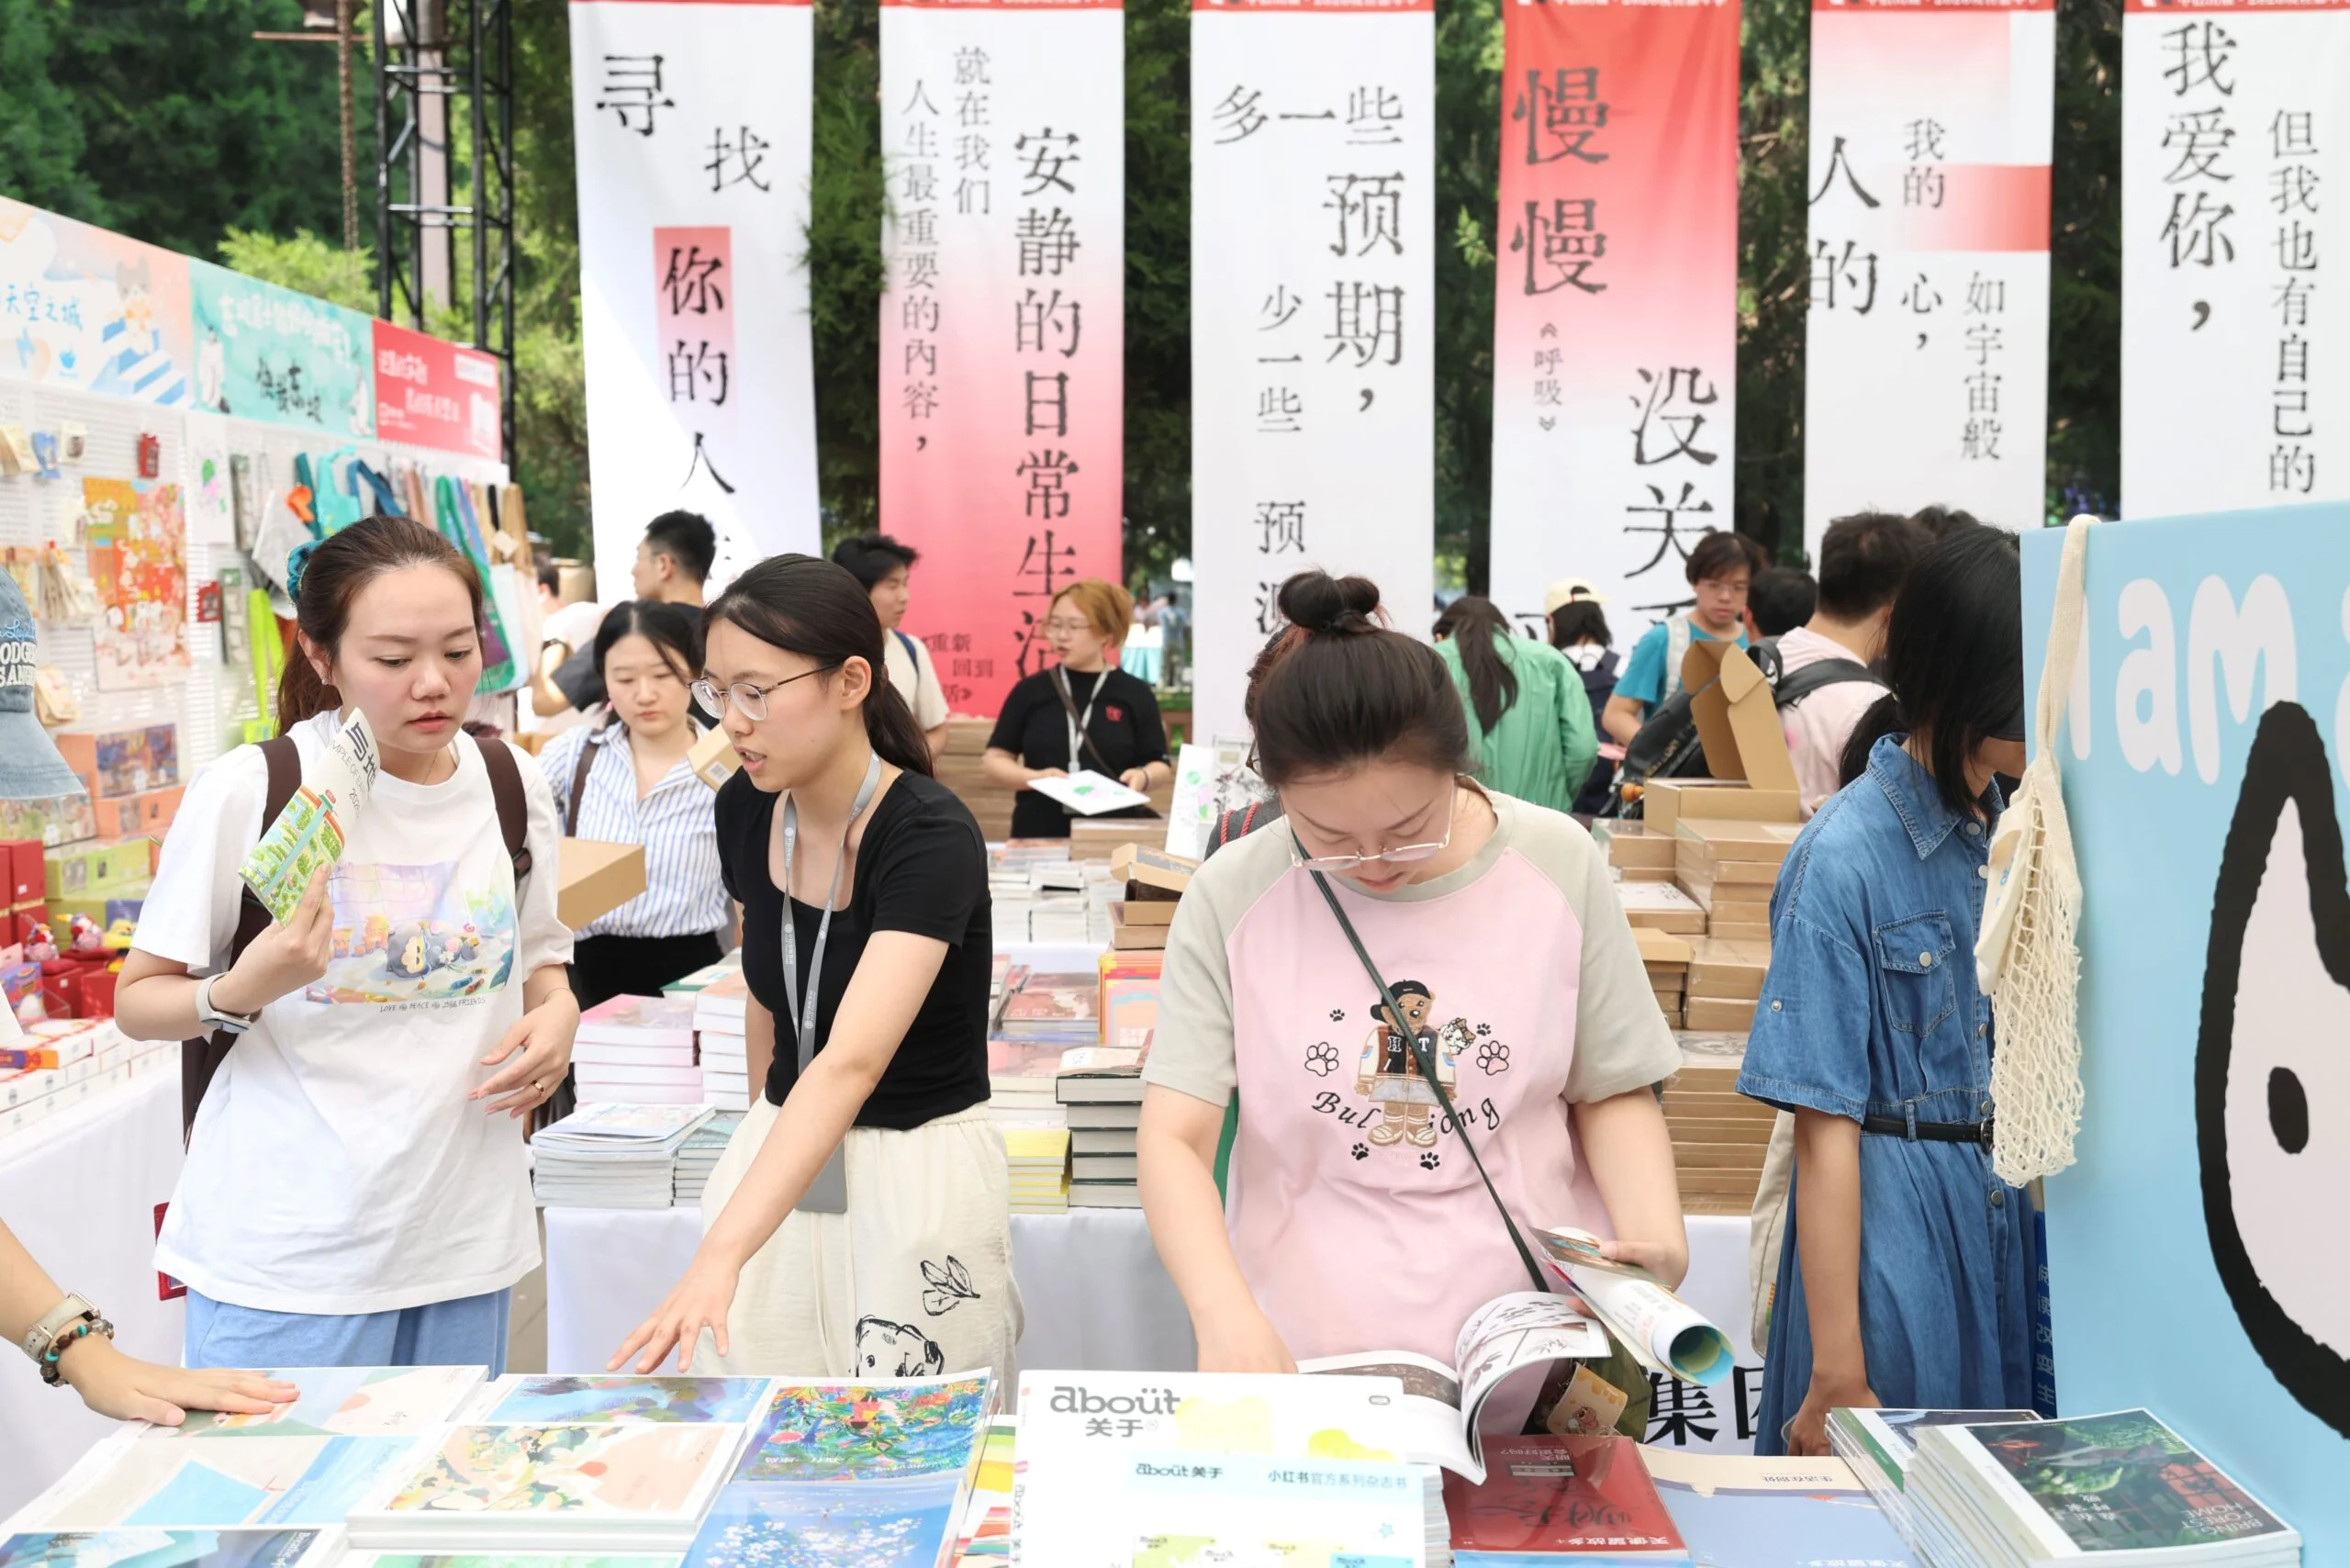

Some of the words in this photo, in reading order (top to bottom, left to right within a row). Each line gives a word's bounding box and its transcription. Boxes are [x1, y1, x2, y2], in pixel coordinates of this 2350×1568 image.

[596, 54, 676, 138] 寻
[704, 125, 772, 194] 找
[953, 46, 992, 217] 就在我们
[1212, 84, 1404, 146] 多一些
[1510, 66, 1610, 297] 慢慢
[2160, 19, 2238, 333] 我爱你，
[1322, 171, 1405, 413] 预期，
[1807, 135, 1882, 316] 人的
[2267, 108, 2322, 495] 但我也有自己的
[662, 245, 735, 562] 你的人
[1960, 270, 2007, 461] 如宇宙般
[1623, 366, 1719, 626] 没关
[379, 1003, 397, 1014] LOVE
[409, 1002, 430, 1010] PEACE
[458, 996, 487, 1007] FRIENDS
[1085, 1417, 1145, 1439] 关于
[1191, 1465, 1224, 1480] 关于
